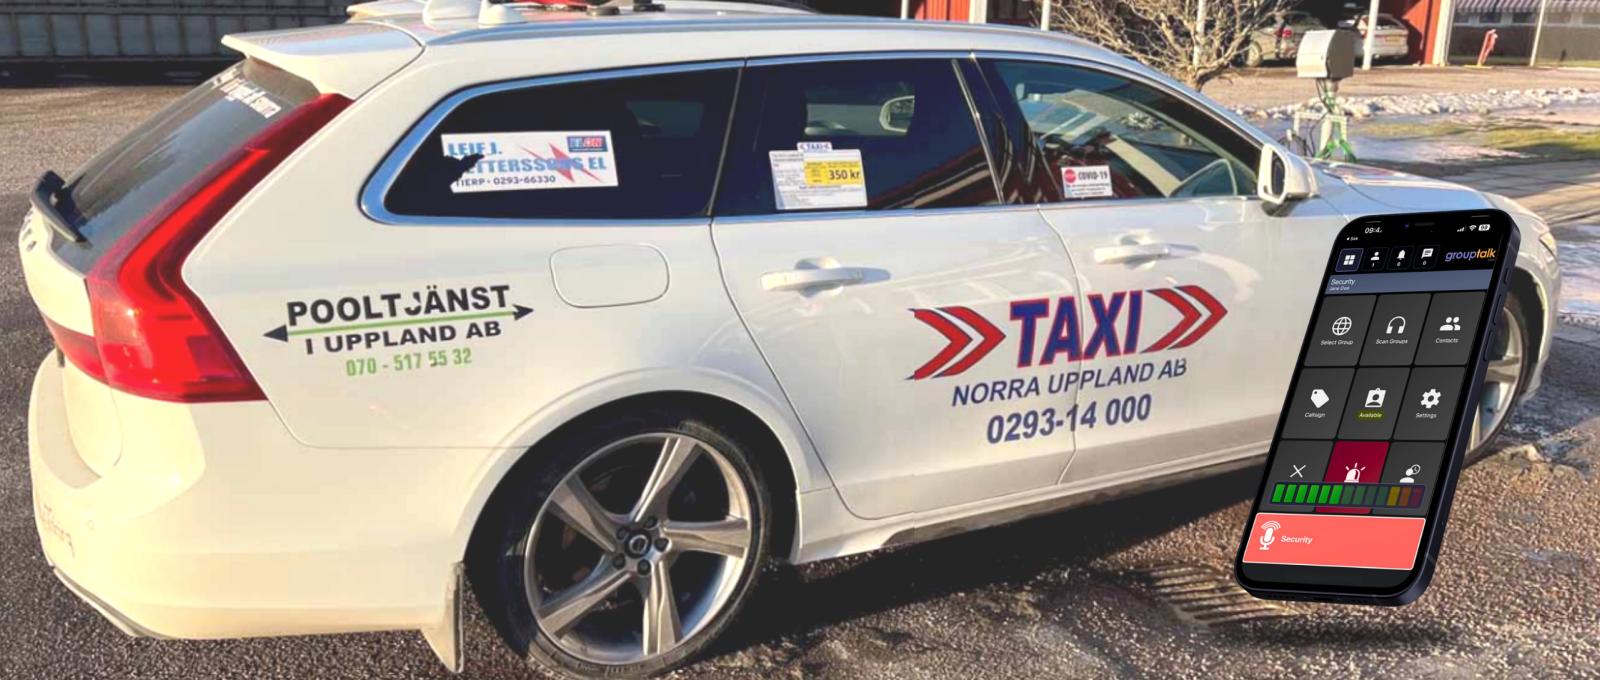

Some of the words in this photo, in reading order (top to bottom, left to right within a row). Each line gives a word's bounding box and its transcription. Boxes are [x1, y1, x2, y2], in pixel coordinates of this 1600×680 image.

[588, 157, 607, 170] EL
[828, 169, 848, 180] 350
[850, 168, 860, 179] kr
[1444, 247, 1496, 262] grouptalk
[1330, 278, 1356, 286] Security
[287, 285, 510, 326] POOLTJÄNST
[305, 338, 314, 355] I
[324, 325, 457, 353] UPPLAND
[465, 320, 502, 339] AB
[1009, 289, 1144, 368] TAXI
[346, 359, 377, 377] 070
[393, 353, 422, 372] 517
[453, 347, 472, 365] 32
[951, 375, 1041, 408] NORRA
[1047, 361, 1154, 395] UPPLAND
[1157, 357, 1188, 381] AB
[986, 401, 1098, 445] 0293-14
[1105, 393, 1152, 426] 000
[1358, 411, 1383, 419] Available
[1281, 535, 1313, 544] Security
